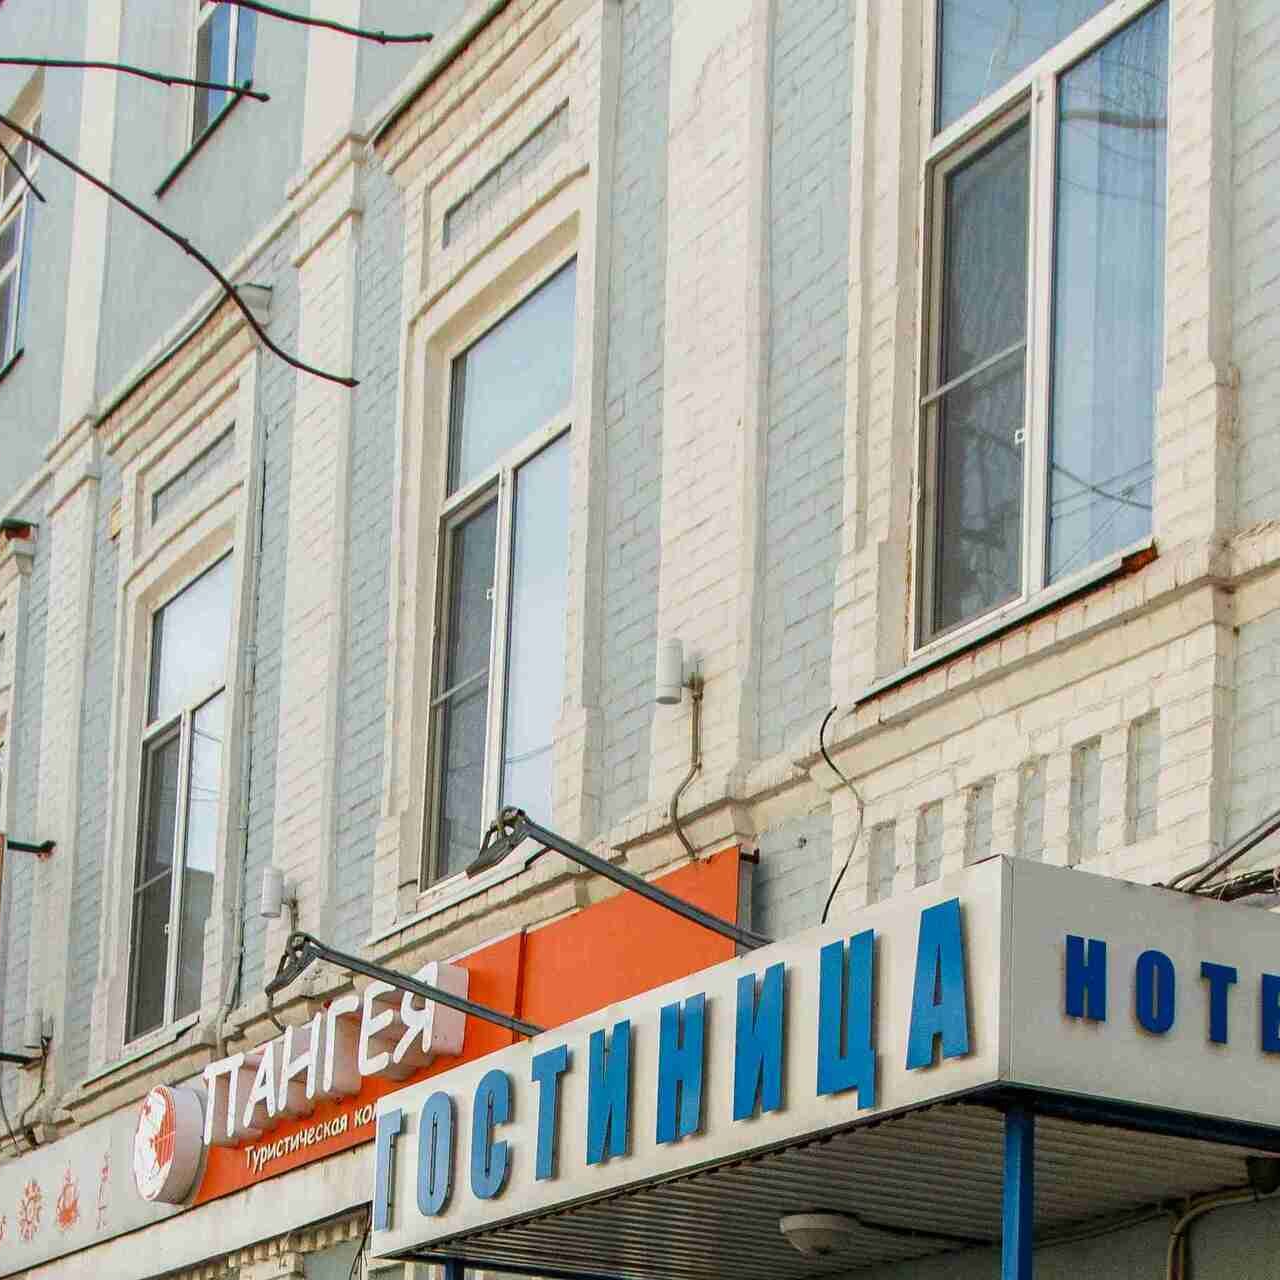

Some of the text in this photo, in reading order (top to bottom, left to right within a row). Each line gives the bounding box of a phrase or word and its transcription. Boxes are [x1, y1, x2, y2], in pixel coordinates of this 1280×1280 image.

[203, 961, 438, 1145] ПАНГЕЯ
[244, 1113, 349, 1175] Туристическая
[375, 897, 969, 1232] ГОСТИНИЦА
